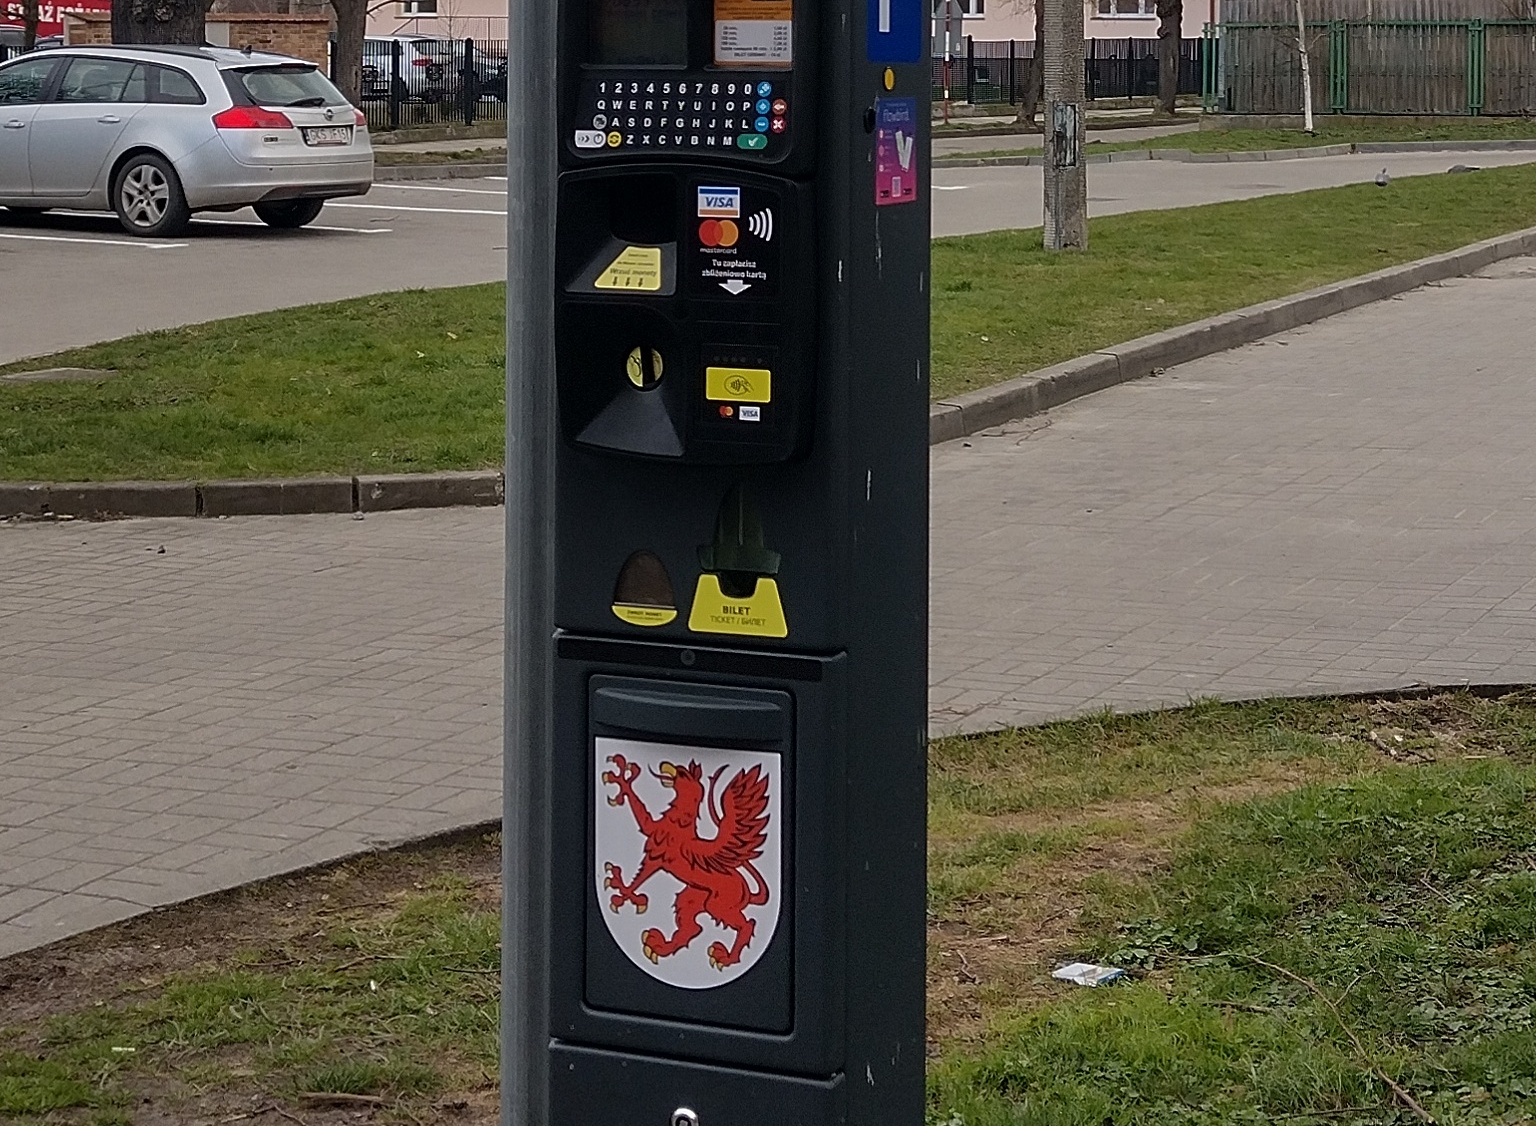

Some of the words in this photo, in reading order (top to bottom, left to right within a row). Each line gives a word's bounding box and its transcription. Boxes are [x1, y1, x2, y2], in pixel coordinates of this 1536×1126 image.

[600, 82, 606, 93] 1
[615, 83, 622, 93] 2
[631, 83, 638, 94] 3
[646, 83, 654, 93] 4
[663, 83, 670, 94] 5
[679, 83, 687, 94] 6
[695, 83, 703, 94] 7
[711, 84, 719, 95] 8
[728, 84, 736, 95] 9
[597, 100, 606, 110] Q
[612, 100, 623, 110] W
[629, 100, 637, 110] E
[645, 101, 653, 110] R
[662, 101, 669, 110] T
[678, 101, 685, 110] Y
[694, 101, 702, 111] U
[726, 102, 735, 111] O
[743, 102, 751, 111] P
[705, 196, 734, 208] VISA
[722, 605, 752, 616] BILET
